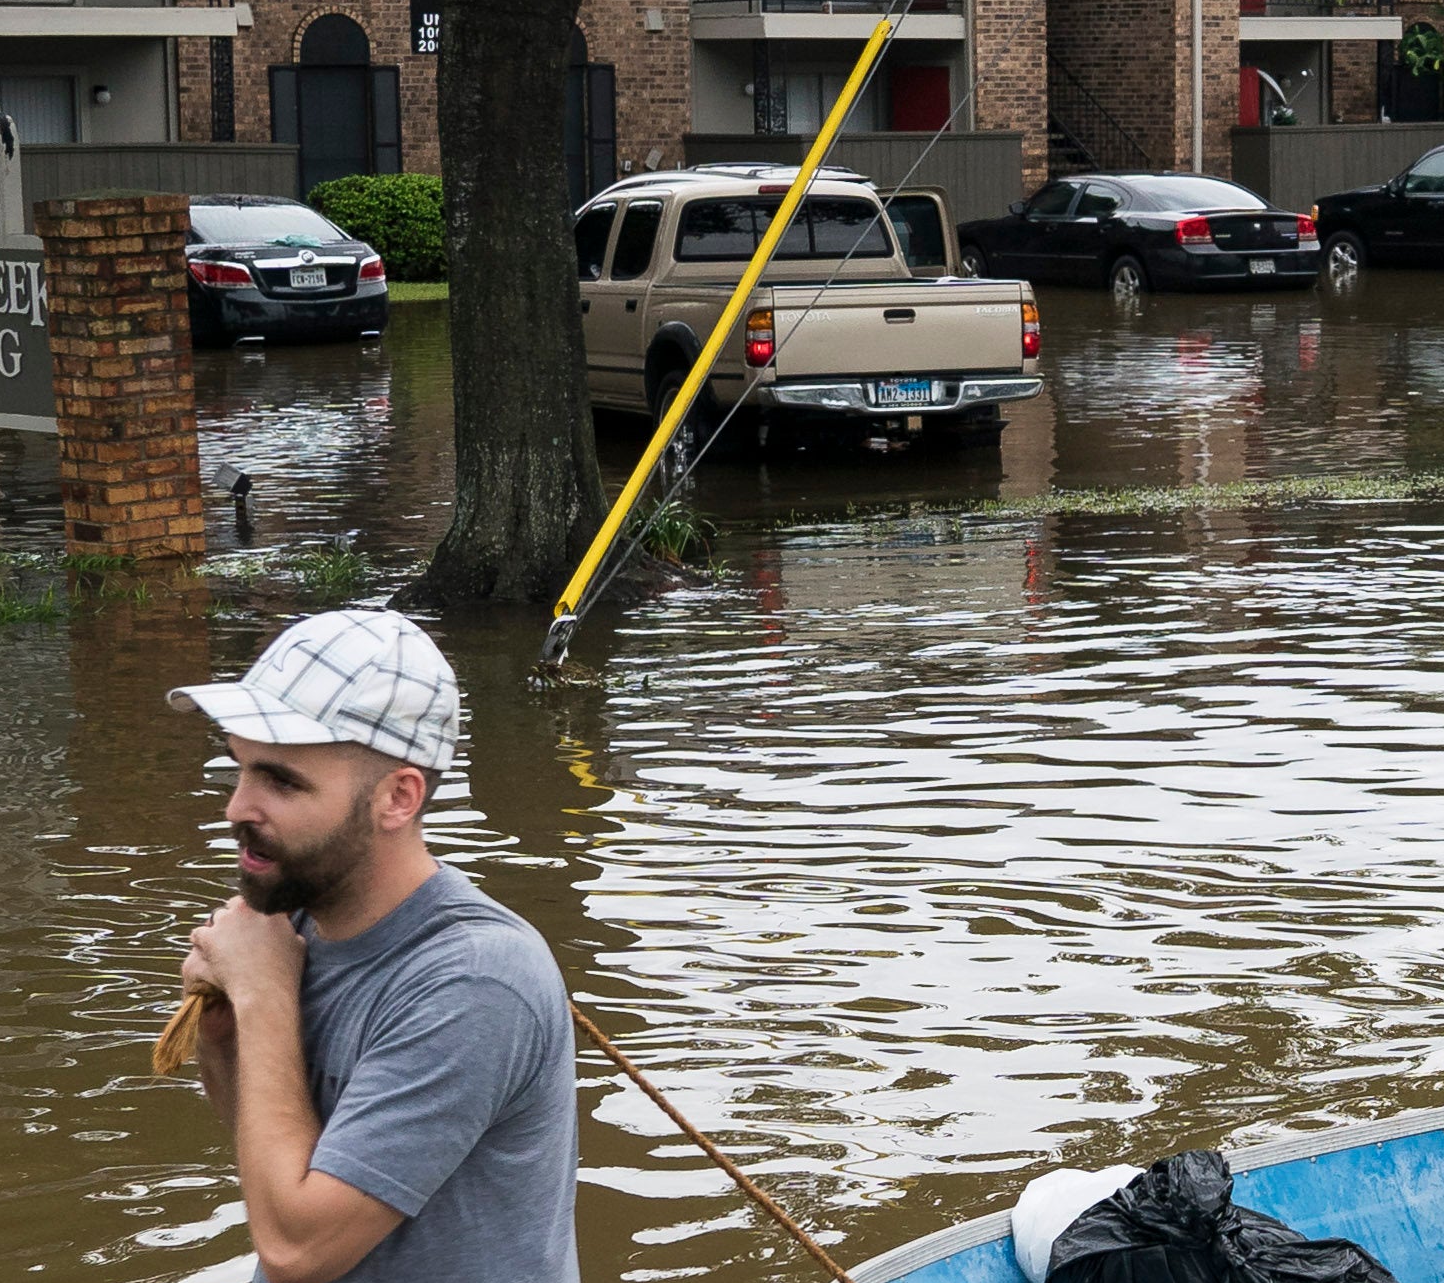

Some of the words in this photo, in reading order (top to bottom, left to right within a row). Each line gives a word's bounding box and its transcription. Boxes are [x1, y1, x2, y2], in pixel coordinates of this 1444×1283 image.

[418, 40, 439, 52] 20
[779, 310, 831, 322] TOYOTA
[974, 306, 1019, 314] TACOMA
